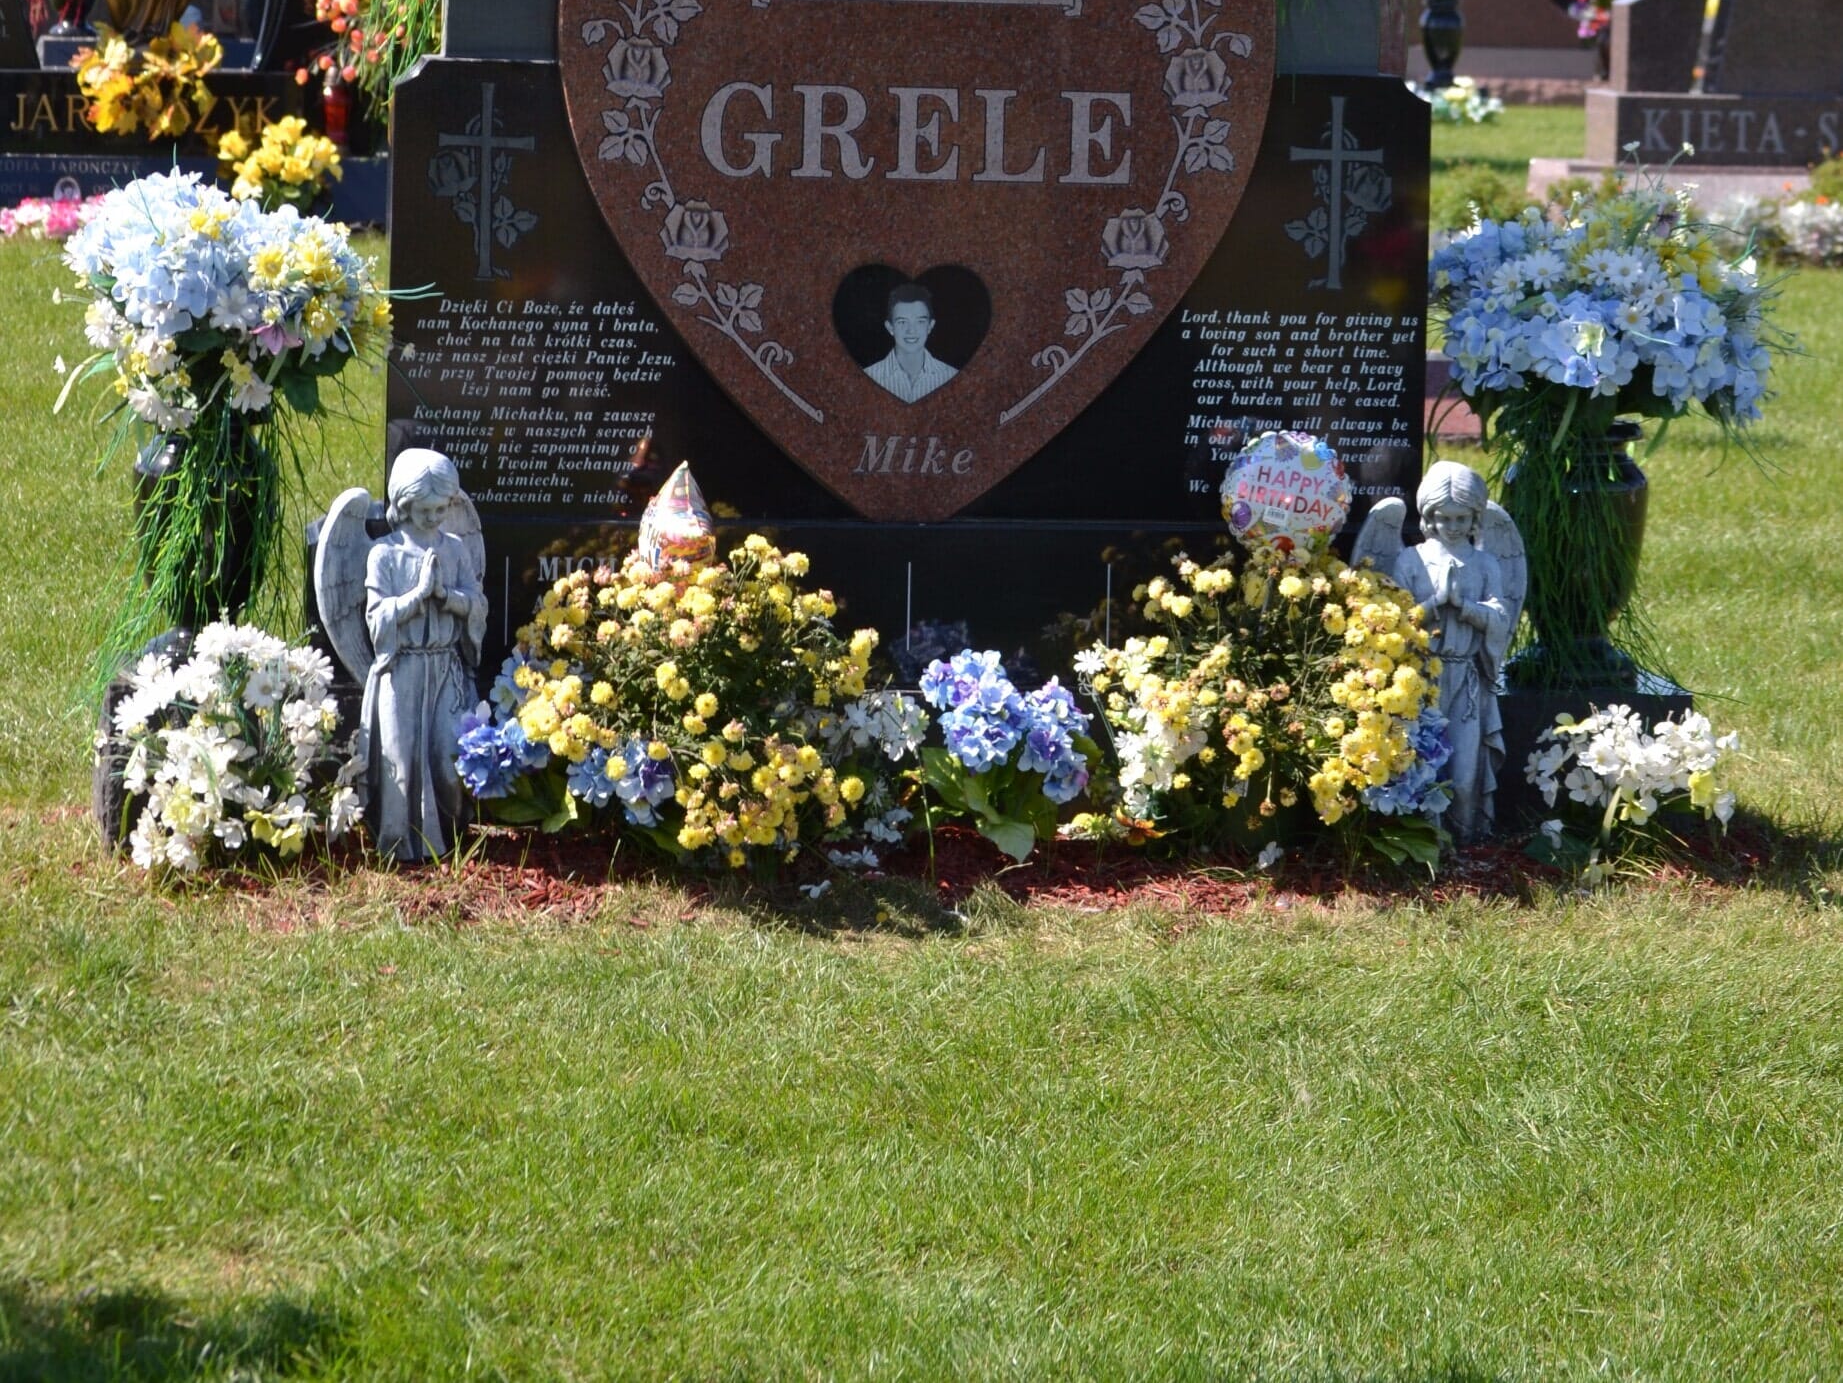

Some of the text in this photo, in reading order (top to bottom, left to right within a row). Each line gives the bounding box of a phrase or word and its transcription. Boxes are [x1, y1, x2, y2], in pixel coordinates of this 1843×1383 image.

[10, 93, 279, 134] JARZYK
[700, 80, 1133, 185] GRELE
[1641, 107, 1785, 154] KIETA
[0, 160, 40, 171] OFIA
[439, 299, 488, 315] Dzięki
[496, 299, 513, 314] Ci
[522, 300, 562, 316] Boże,
[592, 301, 636, 315] dałeś
[416, 316, 659, 333] nam Kochanego syna i brata,
[1181, 309, 1418, 328] Lord, thank you for giving us
[437, 332, 638, 348] choć na tak krótki czas.
[1182, 327, 1416, 344] a loving son and brother yet
[451, 352, 487, 363] nasz
[494, 349, 524, 365] jest
[532, 351, 577, 365] ciężki
[584, 350, 631, 364] Panie
[637, 351, 676, 366] Jezu,
[1211, 343, 1390, 359] for such a short time.
[408, 365, 662, 383] ale przy Twojej pomocy będzie
[1194, 359, 1404, 377] Although we bear a heavy
[499, 385, 531, 397] nam
[542, 386, 560, 399] go
[569, 383, 611, 397] nieść.
[1192, 376, 1406, 393] cross, with your help, Lord,
[1197, 392, 1401, 408] our burden will be eased.
[413, 404, 656, 422] Kochany Michałku, na zawsze
[415, 422, 653, 439] zostaniesz w naszych sercach
[1186, 414, 1408, 432] Michael, you will always be
[445, 439, 489, 454] nigdy
[498, 440, 522, 453] nie
[531, 441, 619, 457] zapomnimy
[628, 444, 637, 455] o
[1184, 432, 1198, 444] in
[1208, 434, 1234, 445] our
[1338, 433, 1412, 448] memories.
[482, 456, 487, 469] i
[497, 455, 548, 470] Twoim
[853, 434, 976, 475] Mike
[1342, 450, 1382, 463] never
[497, 471, 574, 488] uśmiechu.
[1188, 479, 1210, 493] We
[1257, 465, 1326, 495] HAPPY
[562, 494, 574, 503] w
[583, 490, 633, 504] niebie.
[1237, 480, 1334, 522] BIRTHDAY
